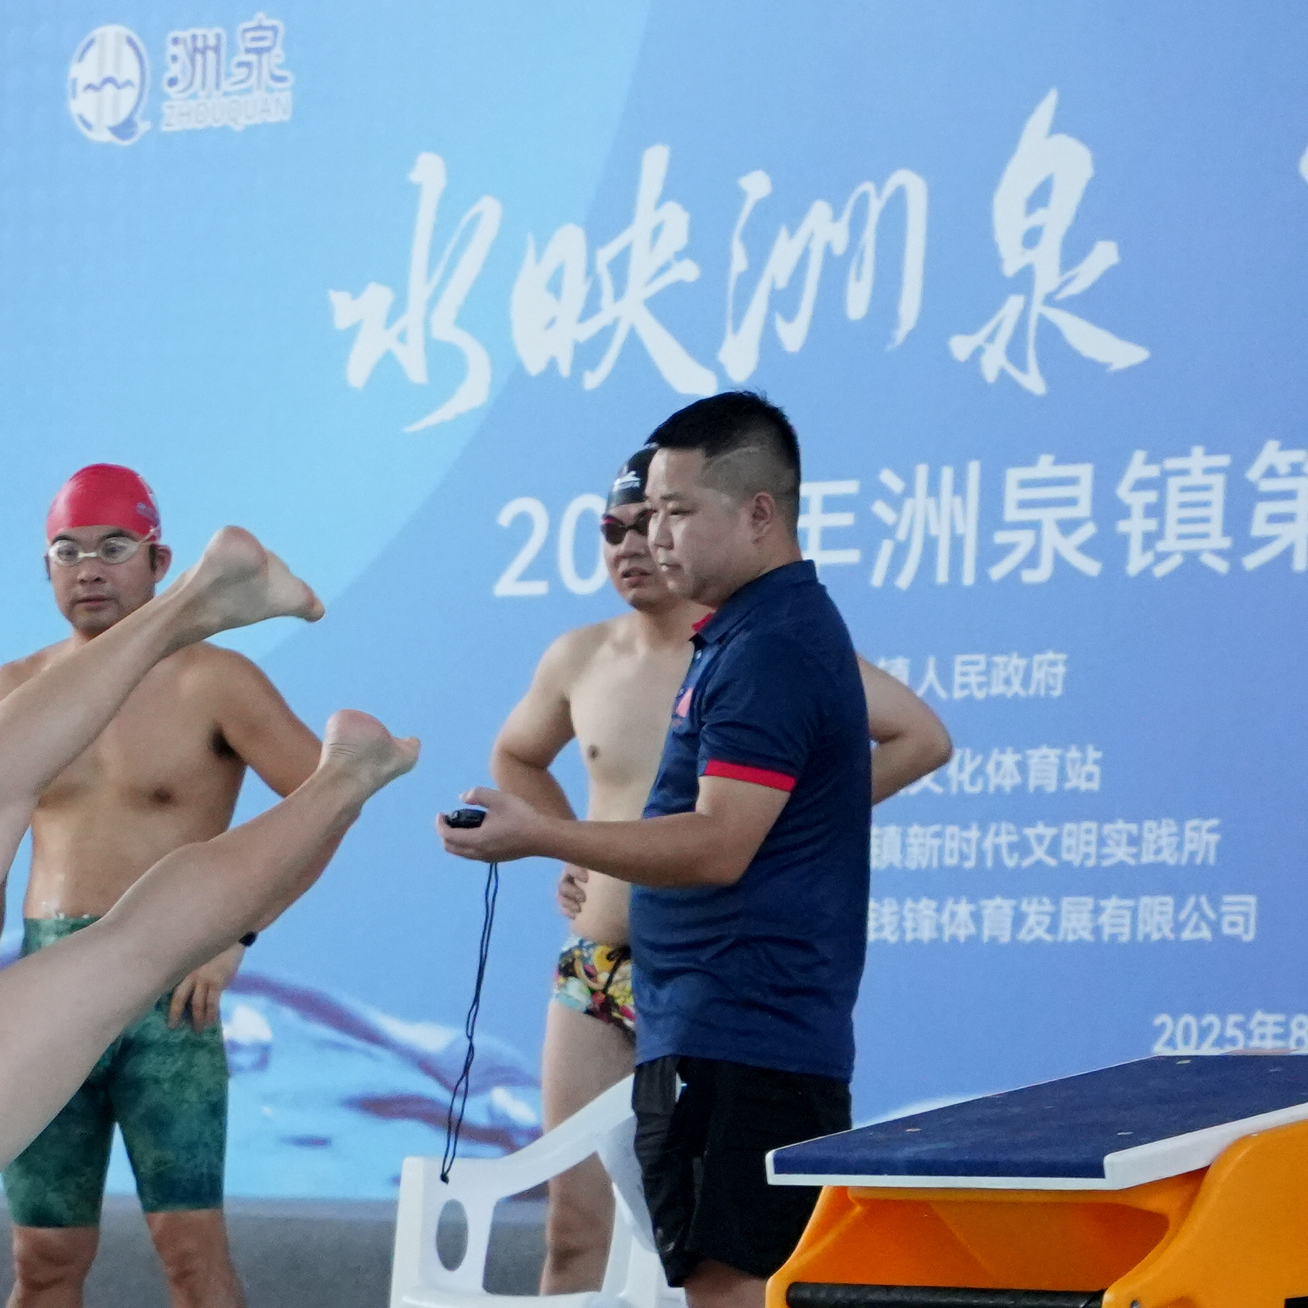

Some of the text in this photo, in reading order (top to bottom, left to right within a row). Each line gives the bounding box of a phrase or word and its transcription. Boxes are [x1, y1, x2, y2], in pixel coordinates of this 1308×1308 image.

[163, 12, 293, 97] 洲泉
[162, 93, 292, 130] ZHOUQUAN
[329, 88, 1151, 433] 水映洲泉
[1151, 1009, 1308, 1053] 2025年8
